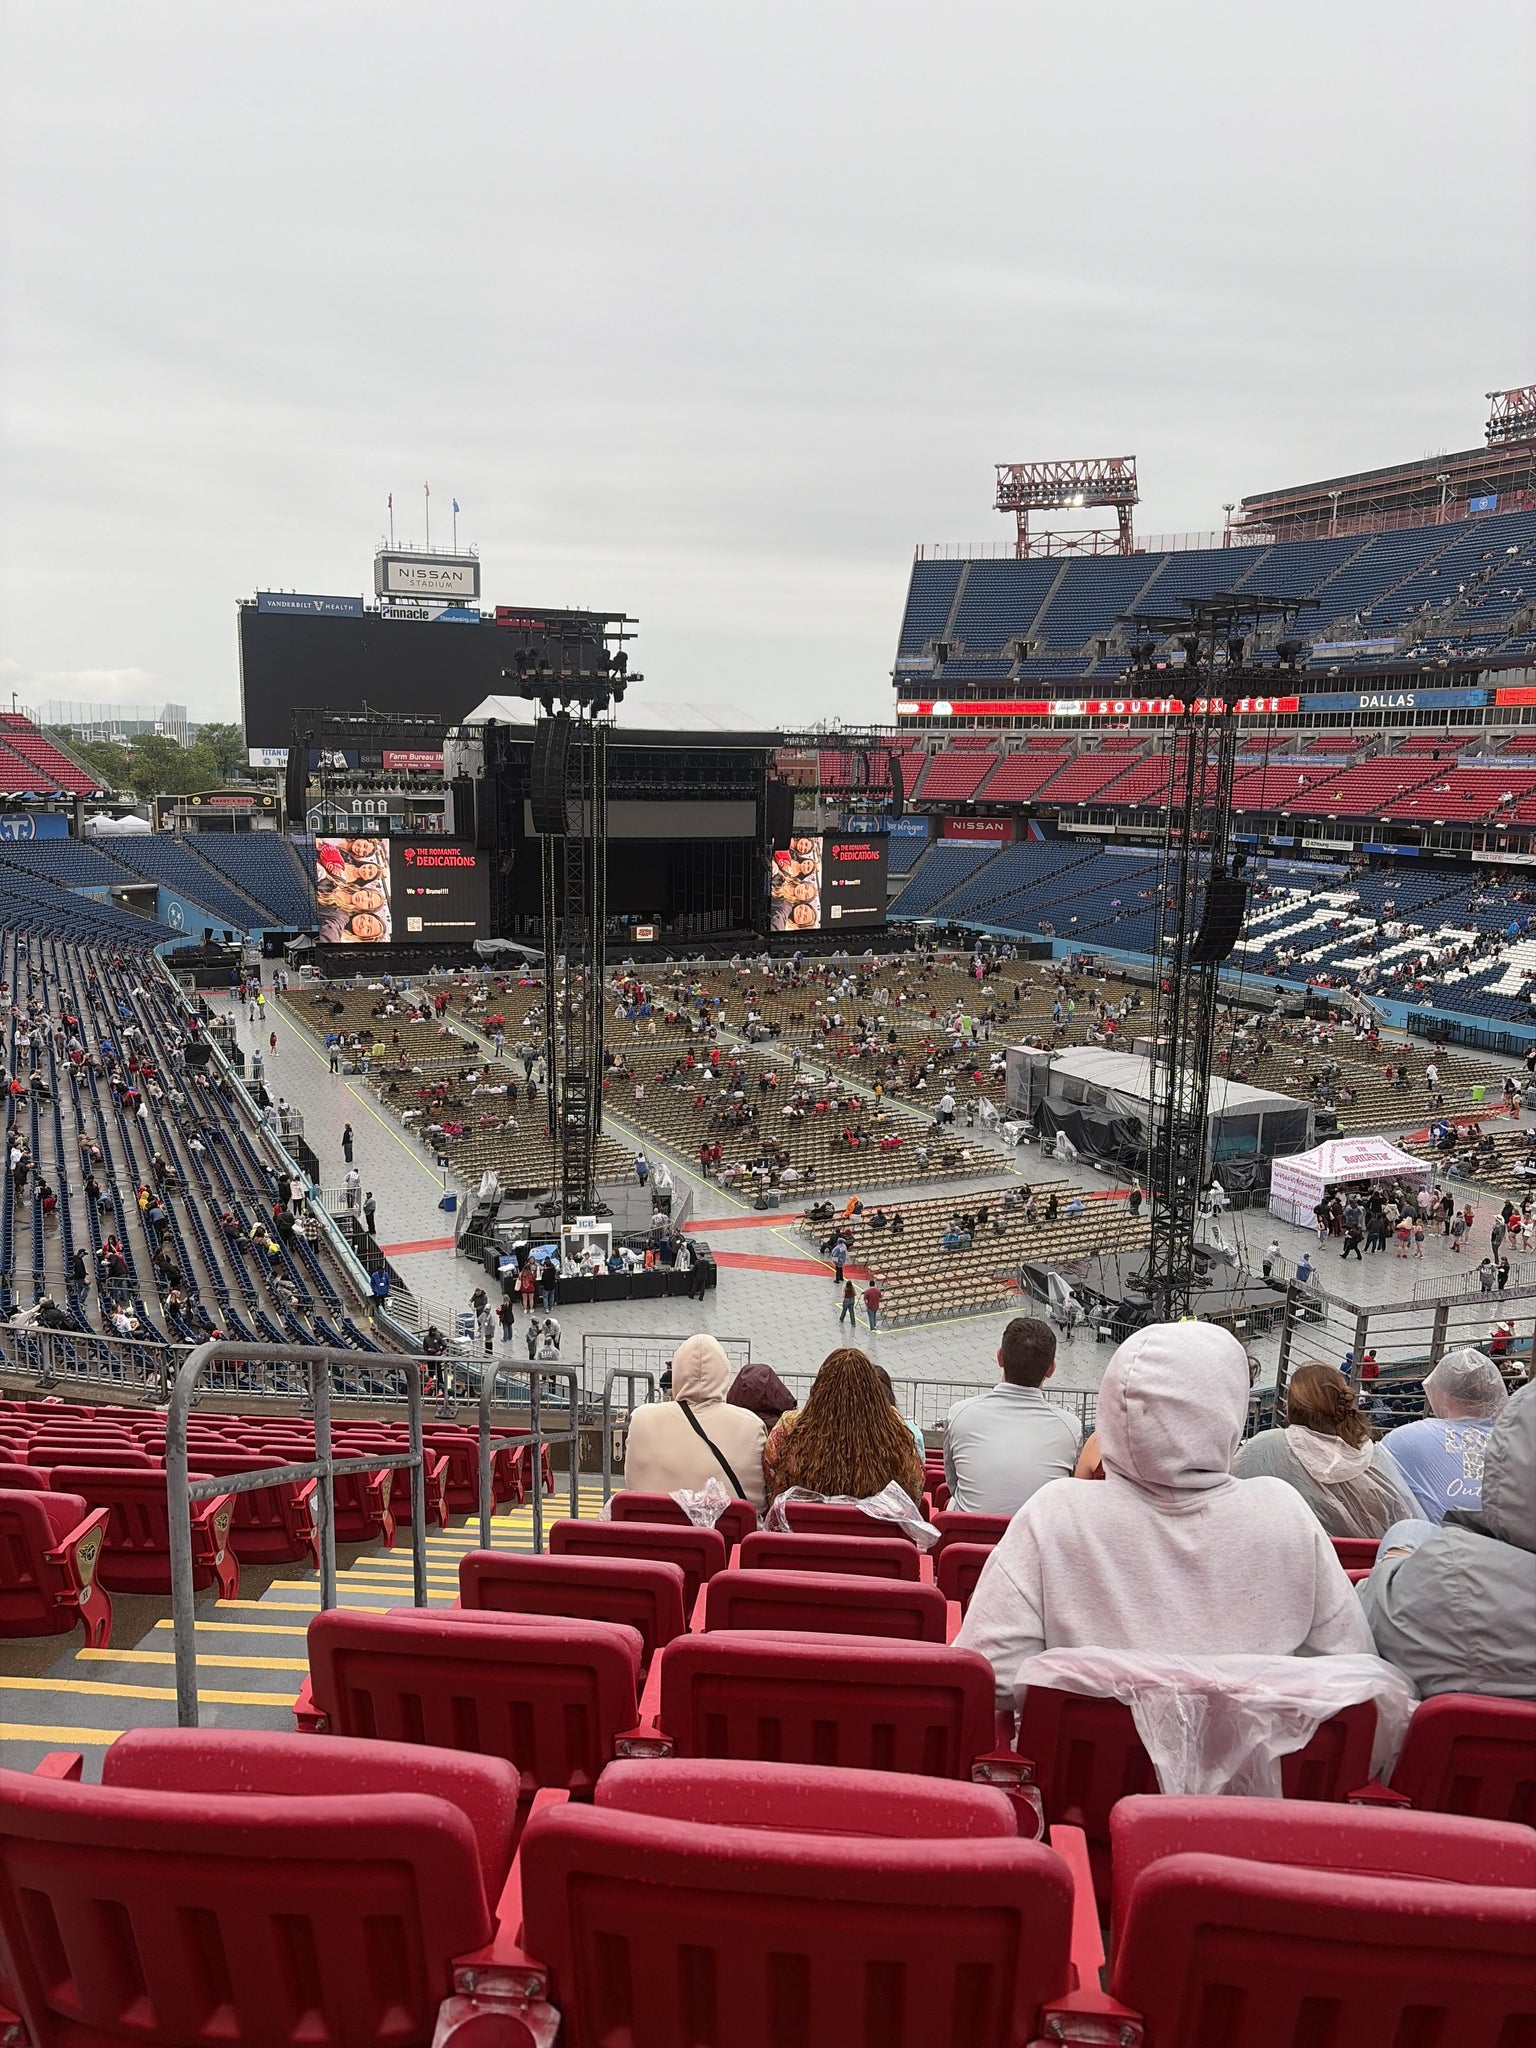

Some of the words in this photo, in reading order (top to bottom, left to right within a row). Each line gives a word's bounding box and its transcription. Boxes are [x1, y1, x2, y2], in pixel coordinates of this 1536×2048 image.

[399, 568, 463, 581] NISSAN
[409, 580, 453, 588] STADIUM
[267, 600, 312, 609] VANDERBILT
[325, 603, 354, 611] HEALTH
[382, 606, 429, 620] Pinnacle
[1099, 700, 1171, 712] SOUTH
[1182, 697, 1279, 712] OLEGE
[1360, 693, 1415, 708] DALLAS
[389, 752, 408, 760] Farm
[409, 753, 434, 761] Bureau
[897, 820, 924, 836] Kroger
[952, 821, 1004, 831] NISSAN
[429, 848, 461, 856] ROMANTIC
[840, 851, 880, 861] DEDICATIONS
[416, 856, 476, 867] DEDICATIONS
[1342, 1152, 1392, 1164] ROMANTIC
[1340, 1172, 1364, 1182] OFFICIAL
[1365, 1169, 1383, 1178] BRUNO
[1384, 1168, 1398, 1176] MARS
[579, 1220, 594, 1228] ICE
[83, 1588, 89, 1601] H
